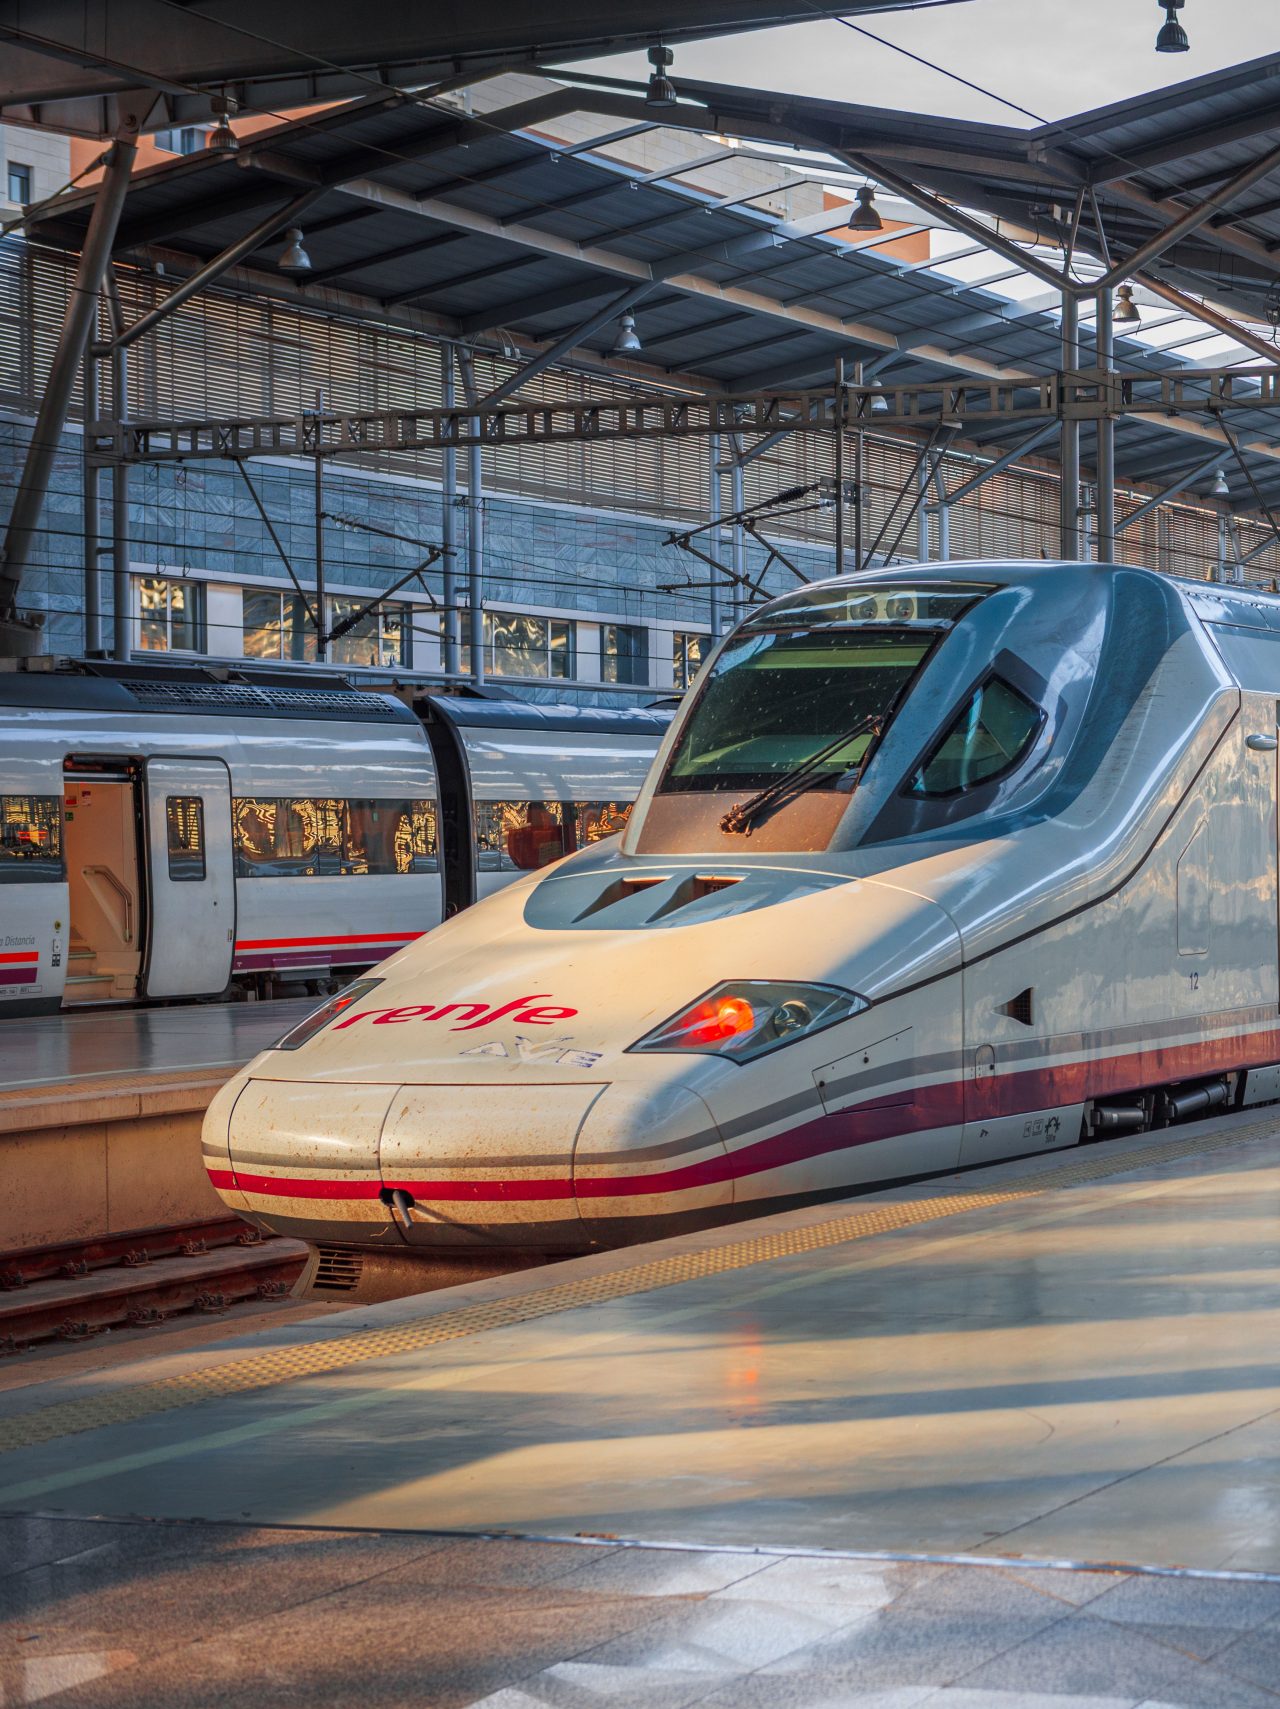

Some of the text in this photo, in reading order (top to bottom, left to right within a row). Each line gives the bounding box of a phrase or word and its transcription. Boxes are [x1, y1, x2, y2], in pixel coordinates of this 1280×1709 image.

[5, 935, 36, 947] Distancia
[1190, 971, 1199, 990] 12
[331, 994, 579, 1032] renfe
[459, 1035, 604, 1069] AVE
